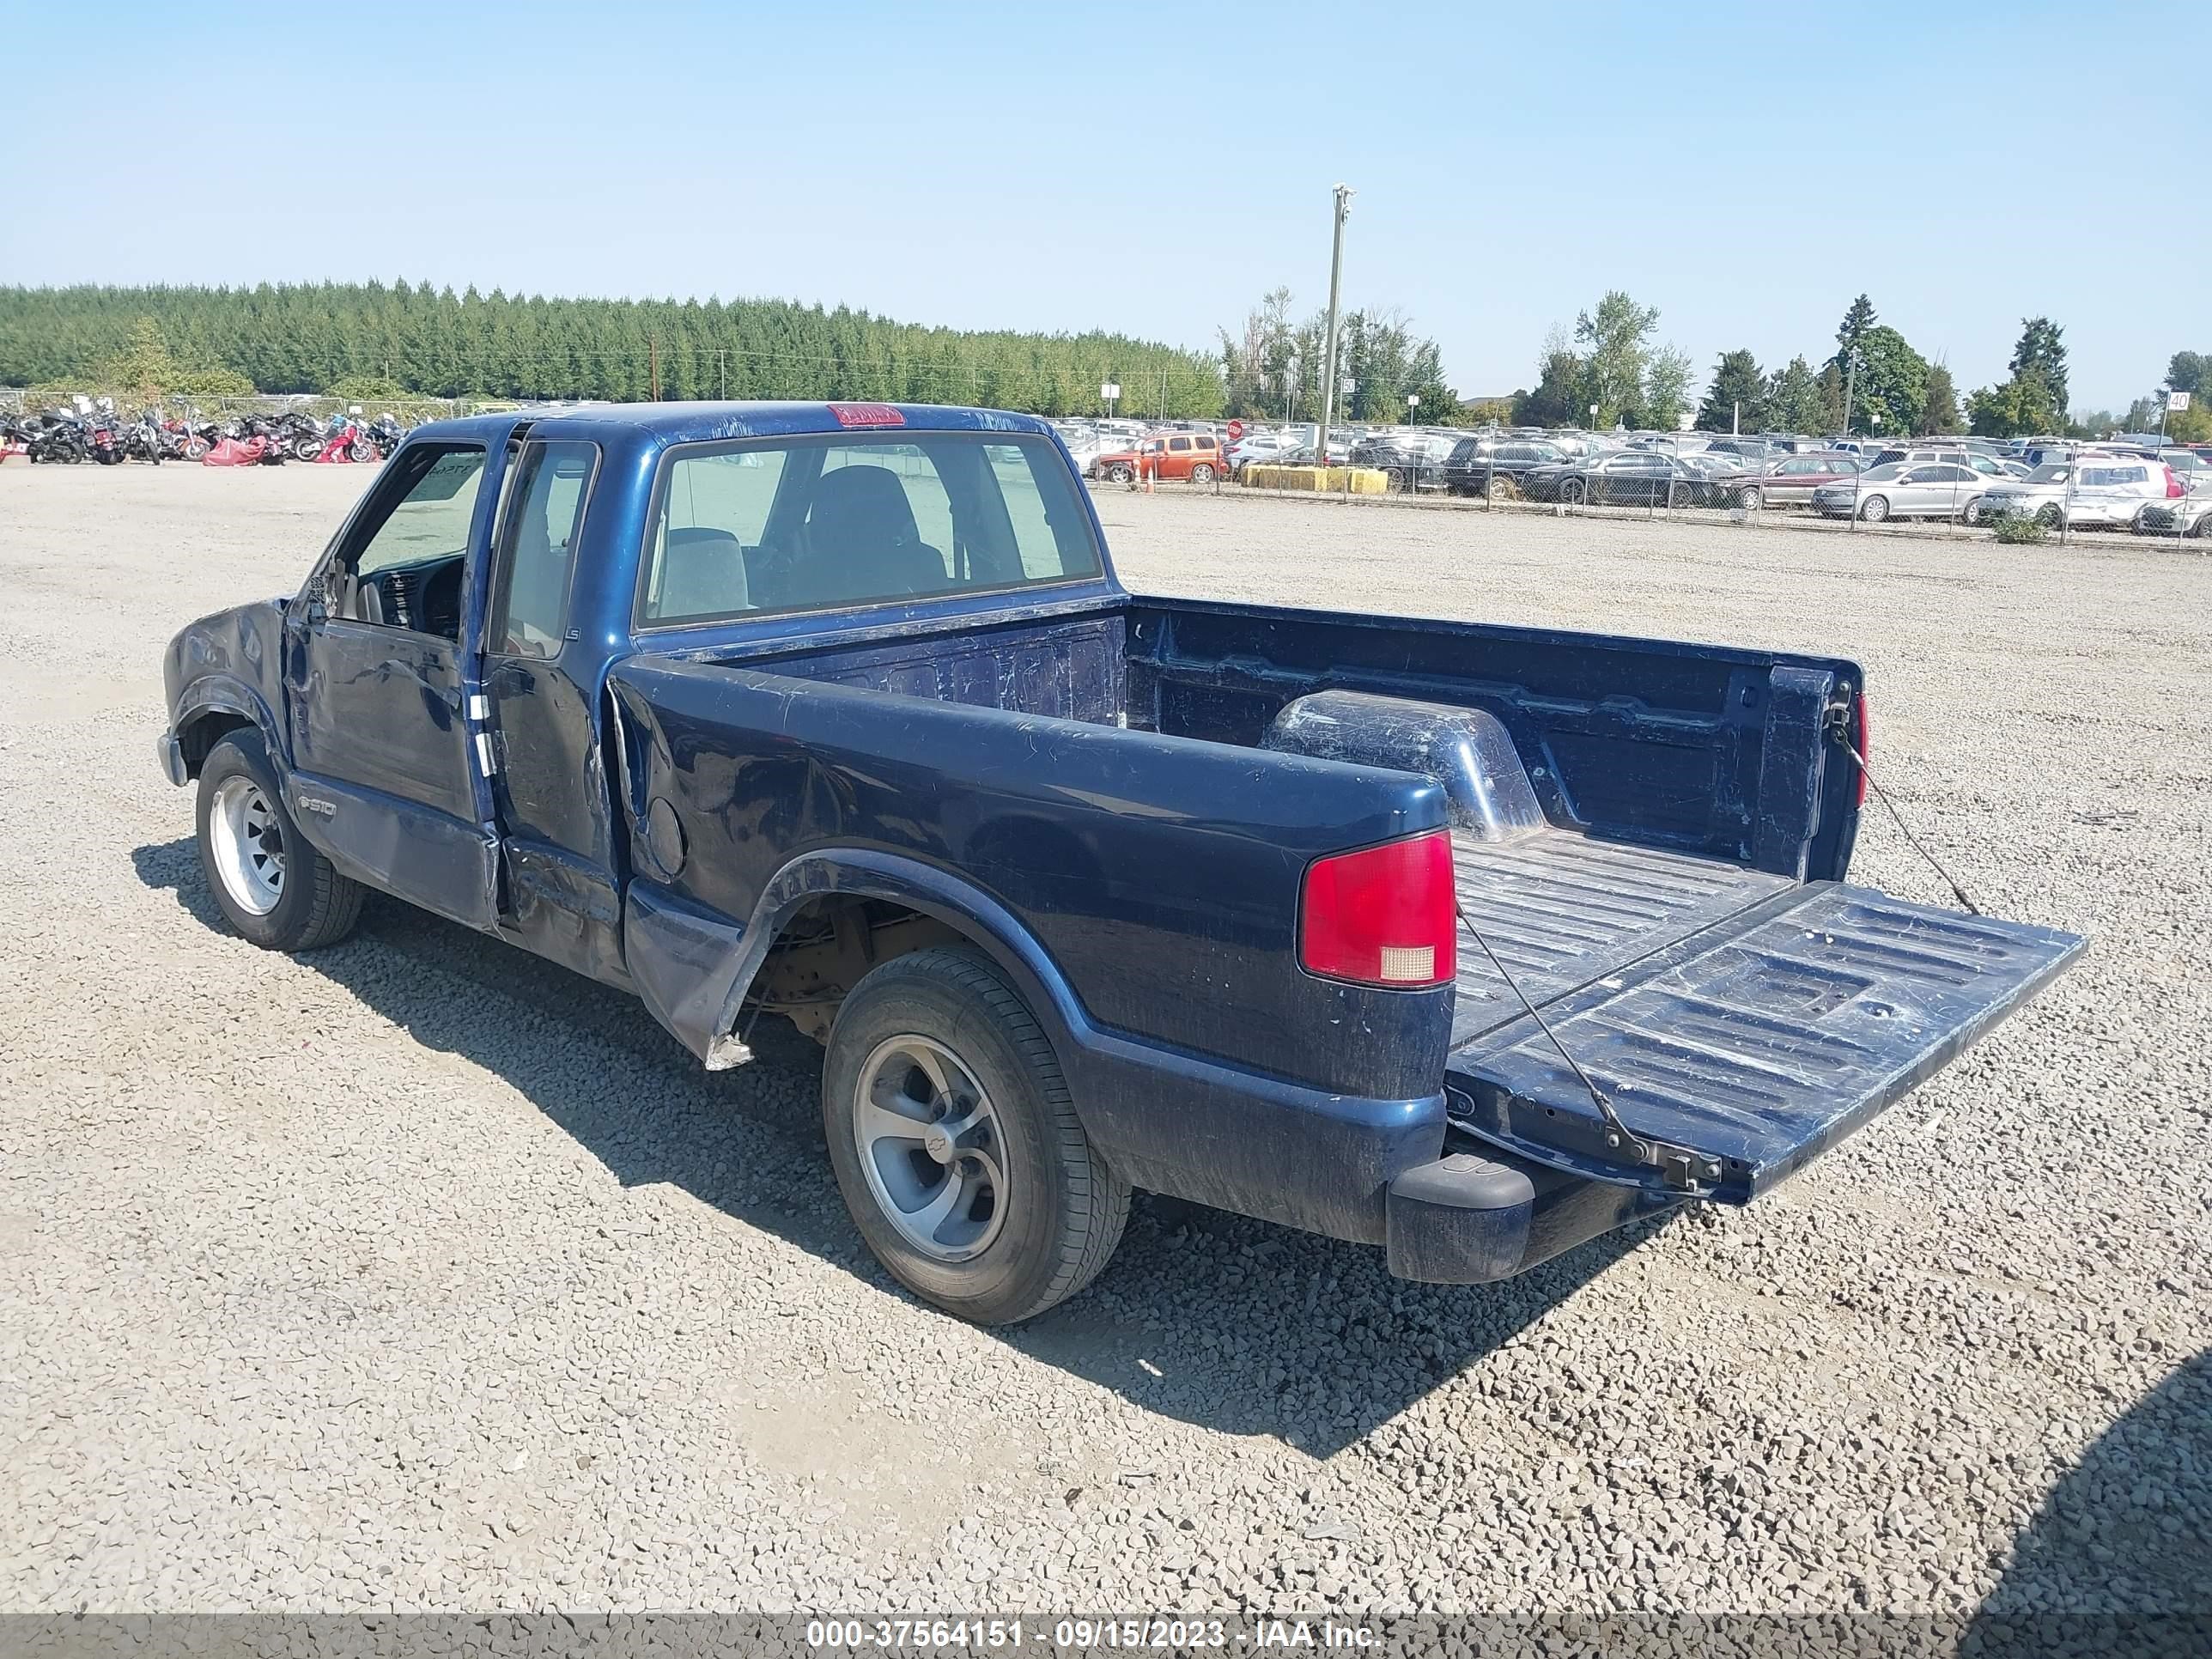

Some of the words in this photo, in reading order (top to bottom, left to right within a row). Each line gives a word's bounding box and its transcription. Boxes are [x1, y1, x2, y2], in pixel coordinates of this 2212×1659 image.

[1344, 380, 1353, 391] 50
[2171, 394, 2188, 408] 40
[1229, 424, 1241, 434] STOP
[565, 629, 579, 640] LS
